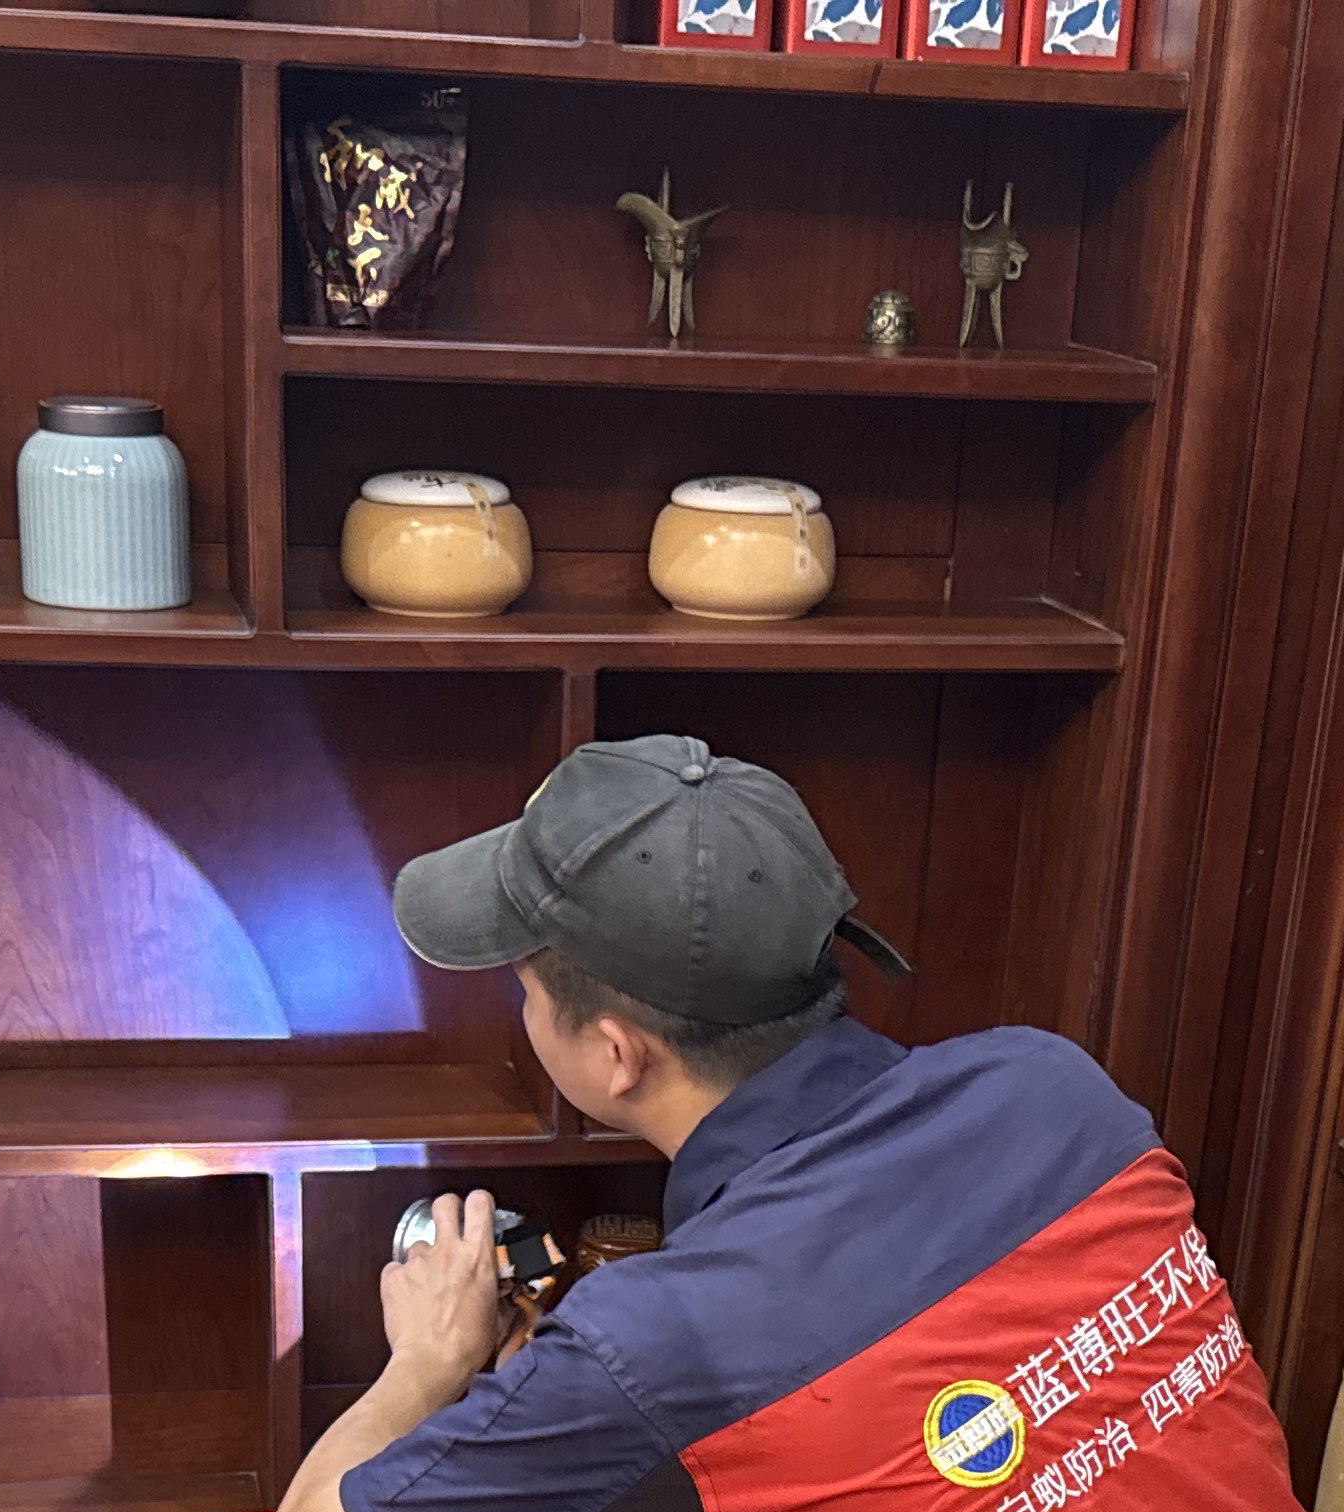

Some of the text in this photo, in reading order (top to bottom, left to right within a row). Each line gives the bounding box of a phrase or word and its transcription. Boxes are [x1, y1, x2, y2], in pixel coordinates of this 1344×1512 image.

[1006, 1225, 1217, 1428] 蓝博旺环保
[1140, 1314, 1246, 1433] 四害防治
